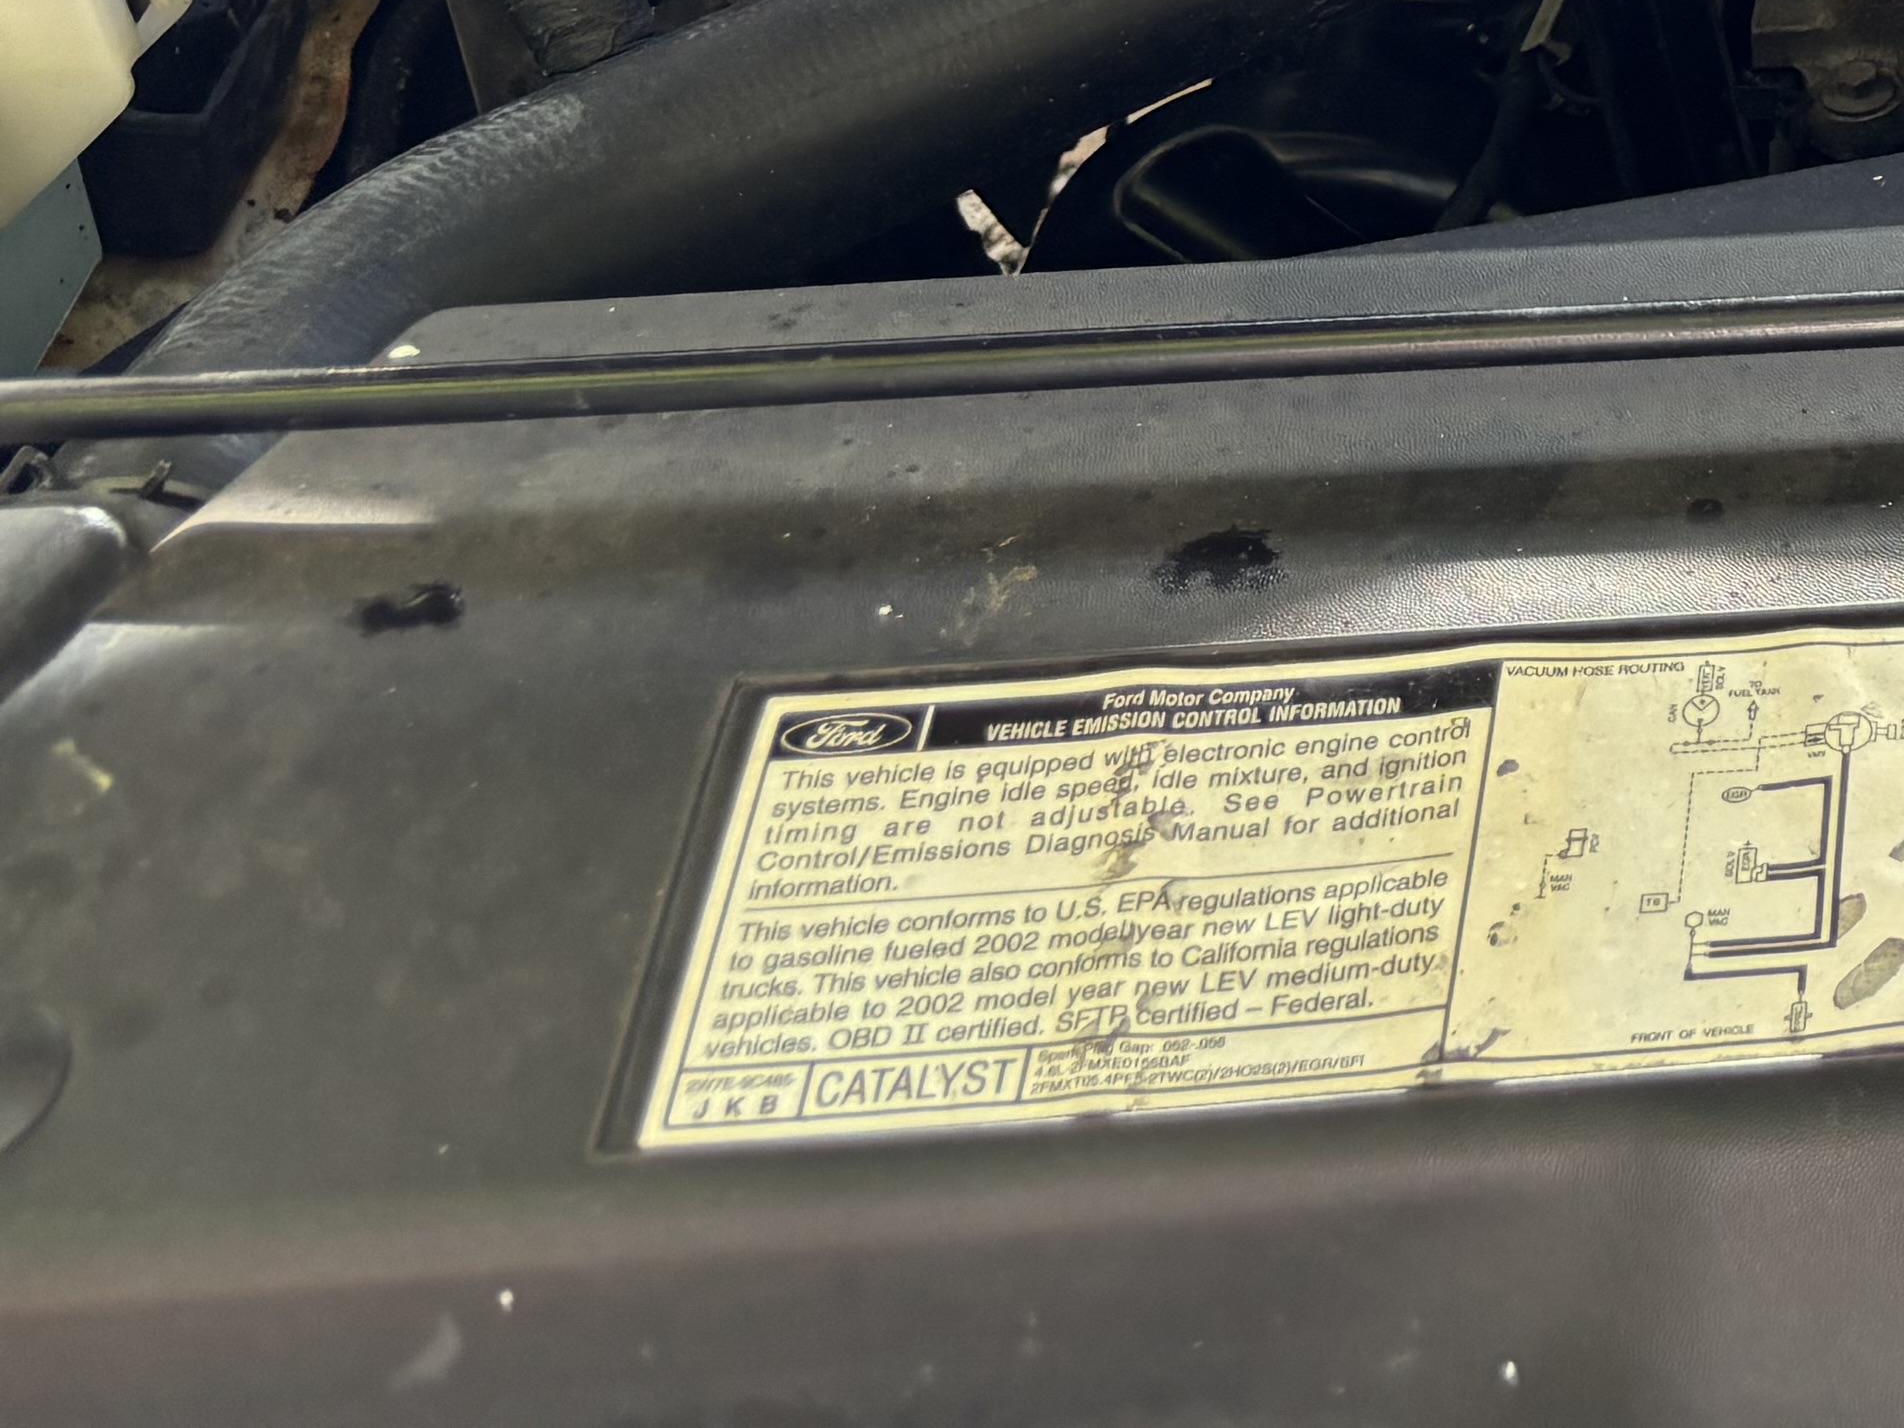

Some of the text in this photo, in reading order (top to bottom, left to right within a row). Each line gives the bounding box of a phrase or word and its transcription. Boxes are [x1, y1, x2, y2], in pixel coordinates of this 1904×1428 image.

[1506, 663, 1569, 678] VACUUM
[1619, 660, 1685, 675] ROUTING
[987, 697, 1401, 741] VEHICLE EMISSION CONTROL INFORMATION
[1102, 687, 1295, 710] Ford Motor Company
[782, 768, 835, 790] This
[846, 762, 935, 787] vehicle
[944, 759, 966, 780] is
[975, 749, 1095, 784] equipped
[1162, 736, 1288, 765] electronic
[1294, 732, 1379, 758] engine
[1386, 718, 1474, 749] control
[804, 719, 885, 749] Ford
[764, 773, 1463, 846] timing are not adjustable. See Powertrain
[771, 749, 1466, 822] systems. Engine idle speed, idle mixture, and ignition
[756, 797, 1460, 872] Control/Emissions Diagnosis Manual for additional
[738, 867, 1449, 942] This vehicle conforms to U.S. EPA regulations applicable
[747, 873, 898, 900] information.
[728, 951, 754, 972] to
[761, 943, 874, 975] gasoline
[883, 935, 967, 961] fueled
[972, 930, 1040, 955] 2002
[1134, 919, 1193, 948] year
[1201, 918, 1256, 937] new
[1264, 907, 1320, 931] LEV
[1327, 896, 1445, 930] light-duty
[720, 924, 1439, 1001] trucks. This vehicle also conforms to California regulations
[1630, 1023, 1755, 1044] FRONT OF VEHICLE
[692, 1094, 778, 1120] J K B
[815, 1057, 1018, 1108] CATALYST
